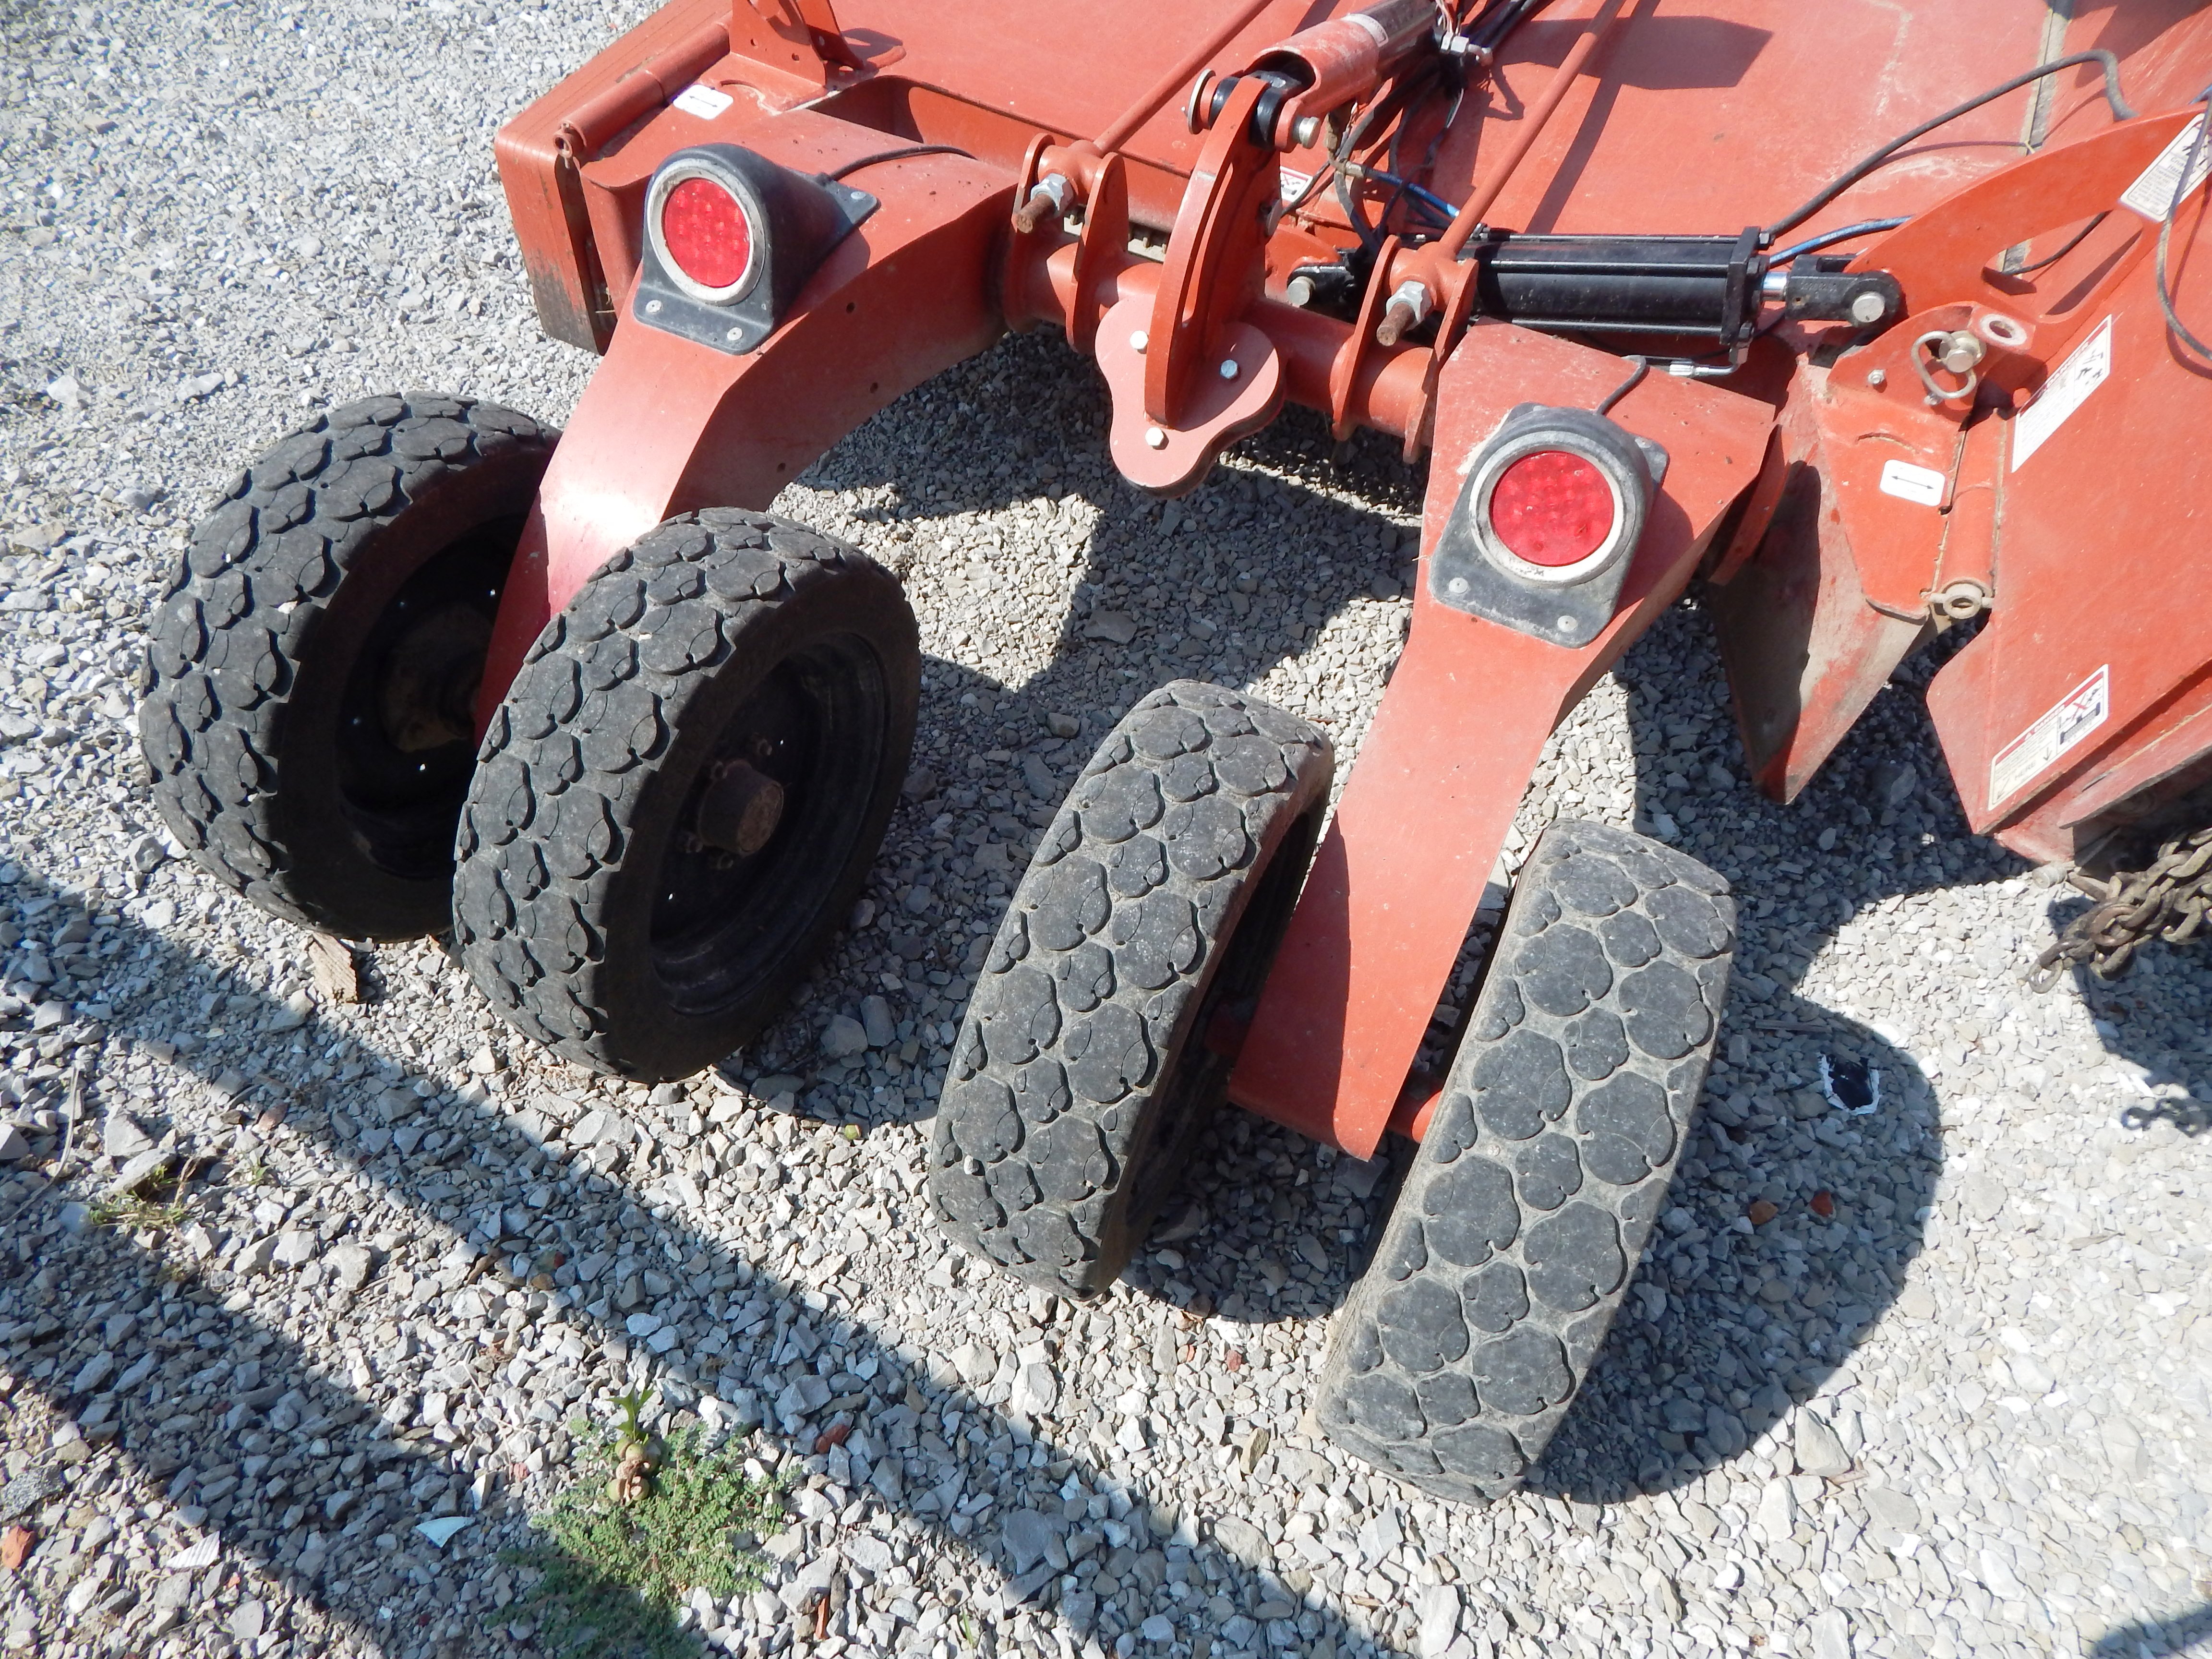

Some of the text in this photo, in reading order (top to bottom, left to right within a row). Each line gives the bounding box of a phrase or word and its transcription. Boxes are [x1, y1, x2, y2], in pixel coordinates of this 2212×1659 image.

[2046, 341, 2089, 388] DANGER
[2034, 704, 2065, 733] DANGER
[2014, 760, 2036, 781] HERE
